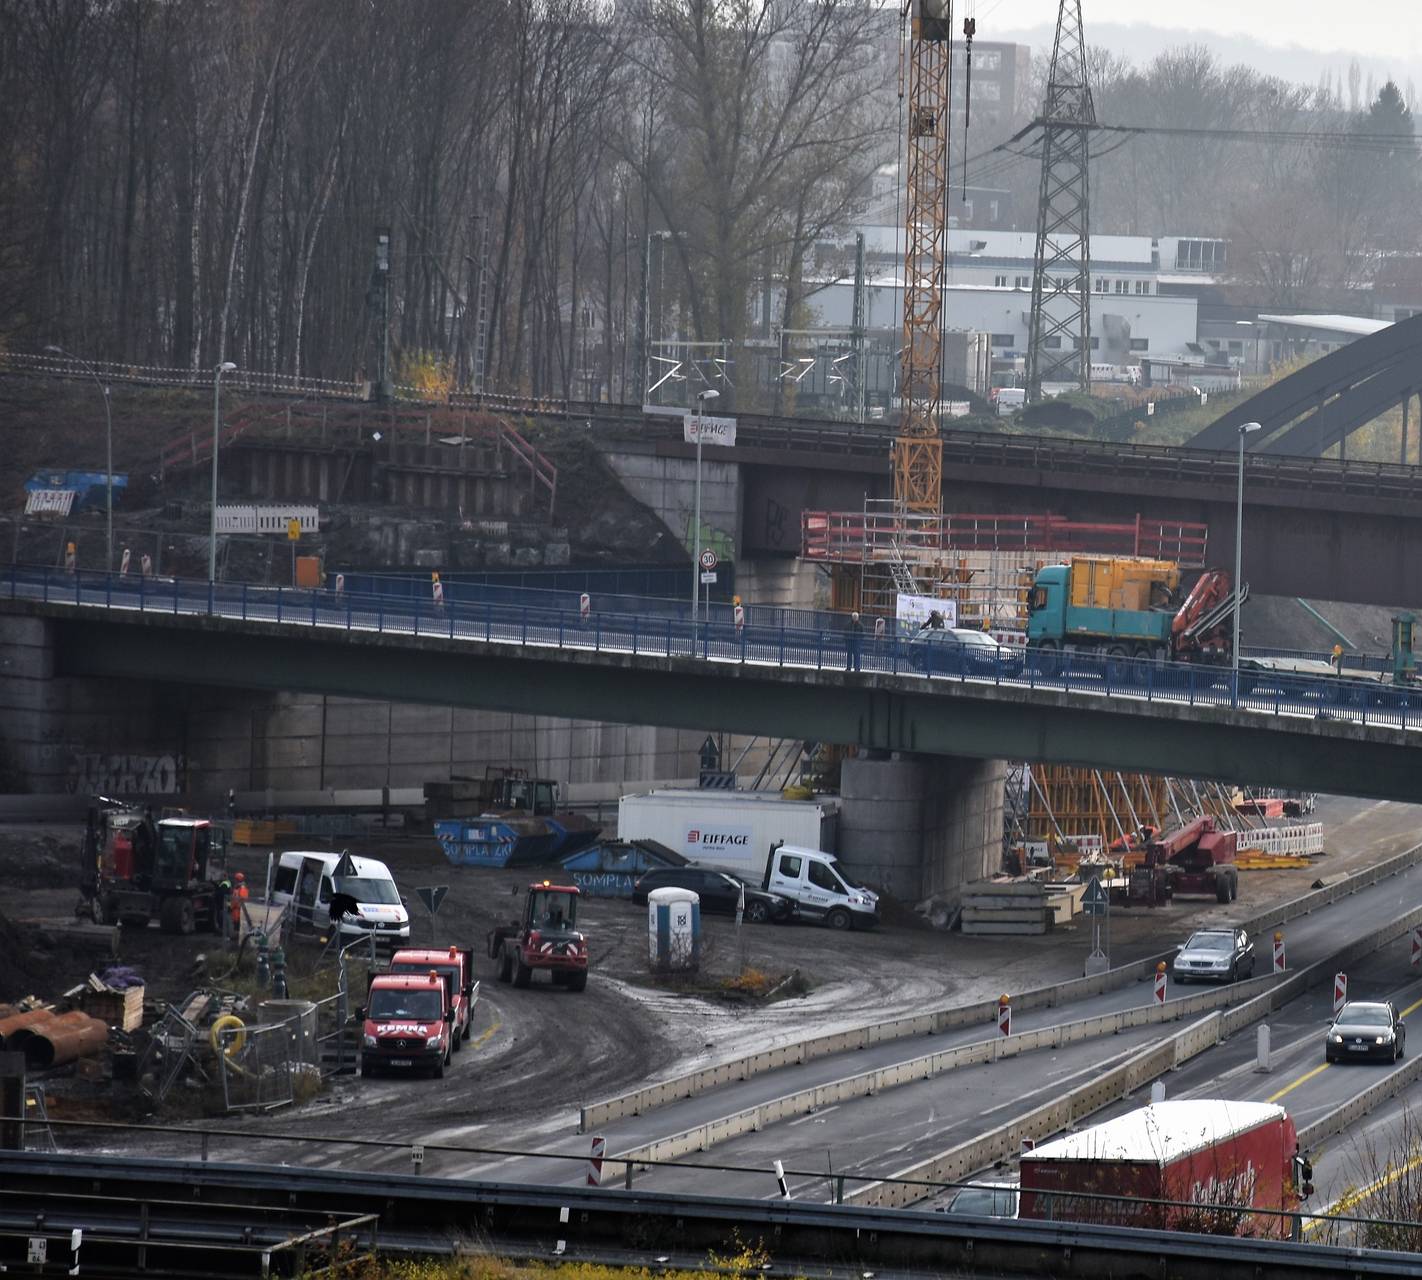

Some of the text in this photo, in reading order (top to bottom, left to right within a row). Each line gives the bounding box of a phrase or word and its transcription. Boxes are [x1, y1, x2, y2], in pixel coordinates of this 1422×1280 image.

[703, 554, 713, 564] 30
[703, 834, 749, 845] EIFFAGE
[442, 841, 513, 857] SOMPLAZKI
[377, 1024, 428, 1033] KEMNA
